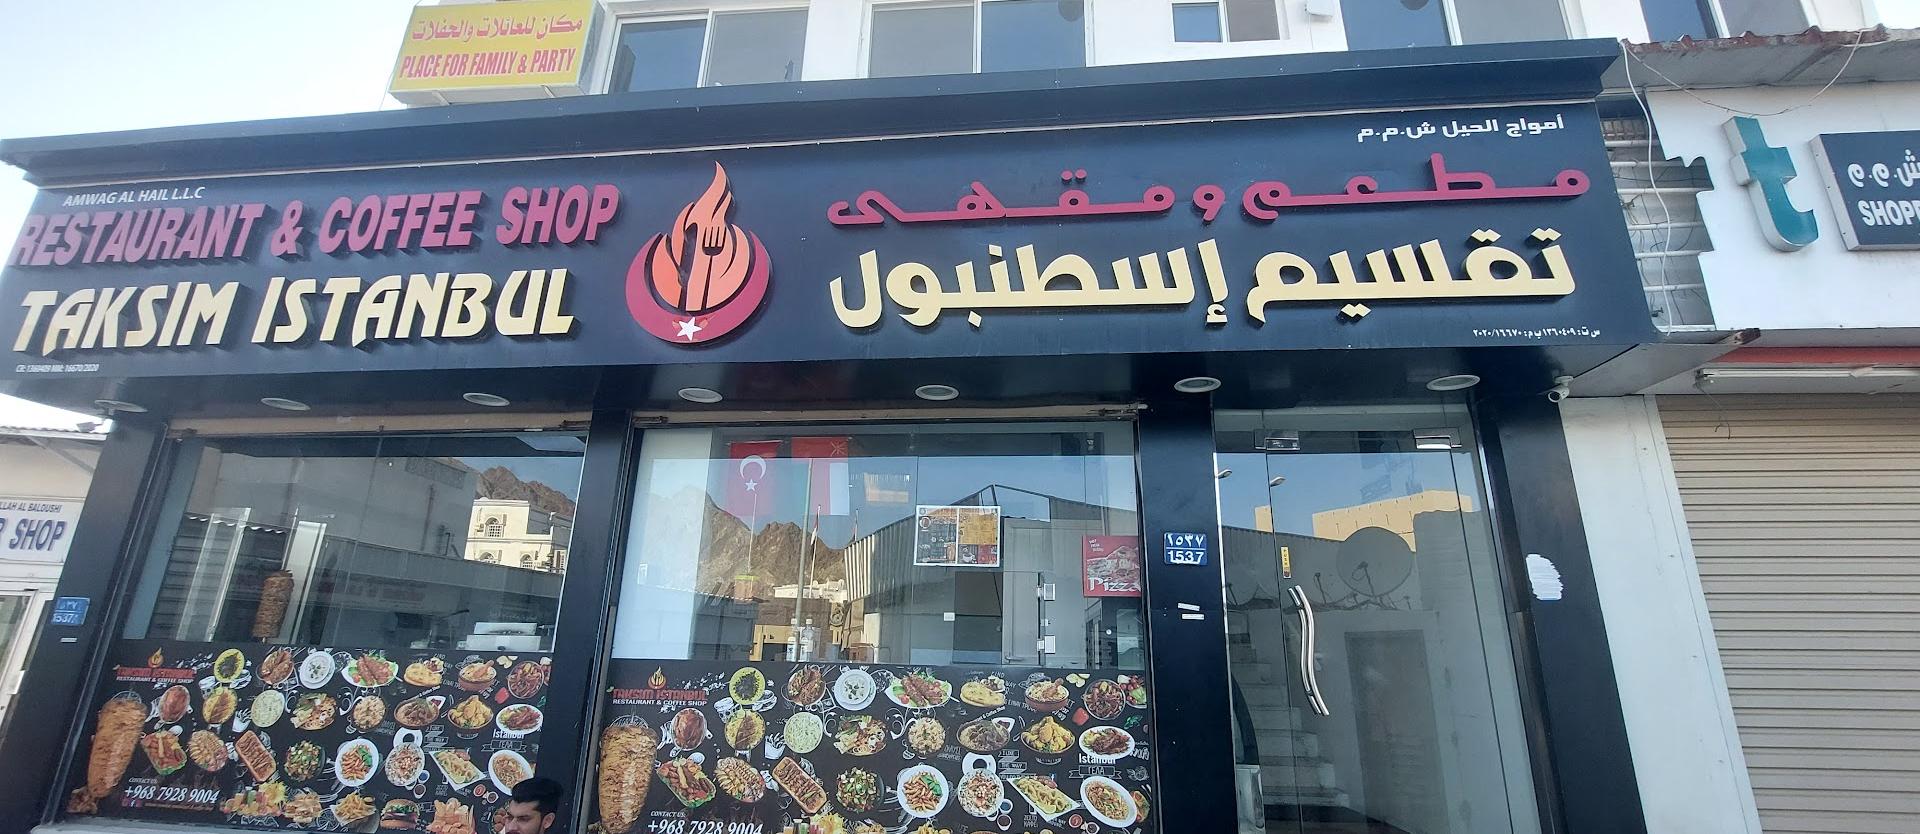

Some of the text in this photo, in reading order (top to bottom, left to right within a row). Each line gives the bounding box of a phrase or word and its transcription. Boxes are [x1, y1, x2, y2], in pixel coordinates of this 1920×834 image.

[412, 14, 583, 43] مكان للعائلات والحفلات
[400, 48, 576, 78] PLACE FOR FAMILY & PARTY
[1441, 119, 1499, 138] الحيل
[1506, 114, 1564, 137] أمواج
[63, 186, 206, 207] AMWAG AL HAIL L.L.C
[1243, 153, 1591, 221] مطعم
[9, 183, 621, 266] RESTAURANT & COFFEE SHOP
[829, 228, 1576, 328] تقسيم إسطنبول
[13, 268, 576, 356] TAKSIM ISTANBUL
[17, 502, 27, 511] AL
[9, 518, 66, 551] SHOP
[1167, 533, 1204, 547] ١٥٣٧
[1168, 550, 1204, 564] 1537
[612, 688, 707, 701] TAKSIM ISTANBUL
[124, 784, 220, 804] +968 7928 9004
[650, 810, 677, 818] CONTACT
[647, 819, 764, 834] +968 7928 9004
